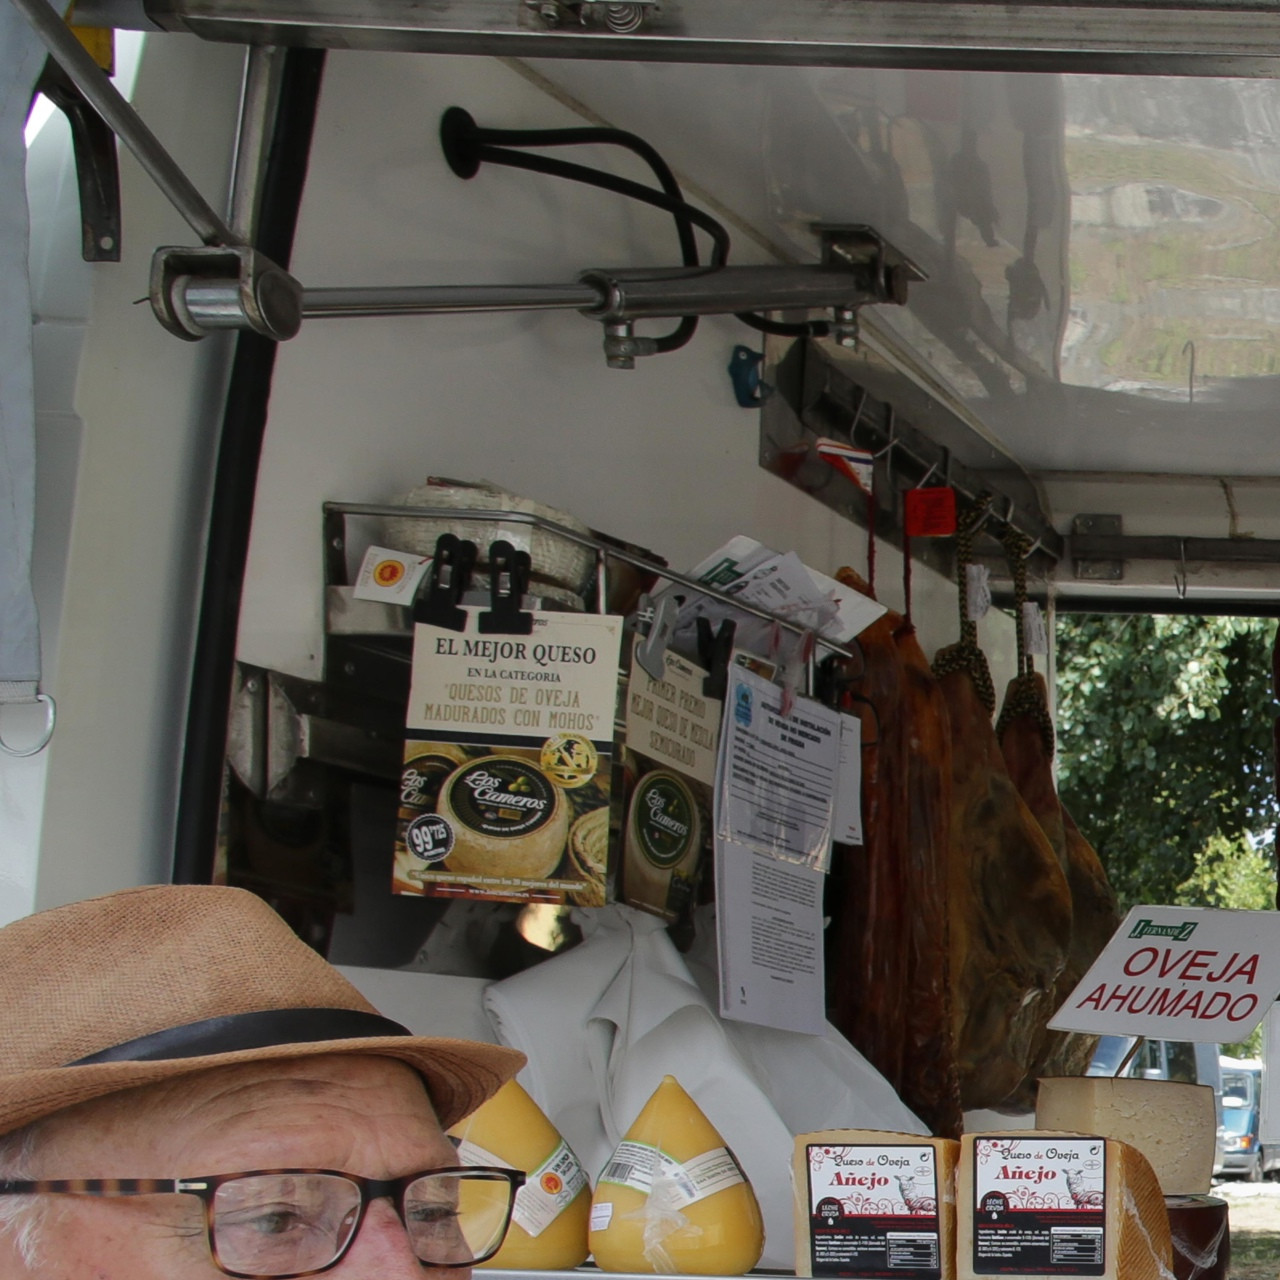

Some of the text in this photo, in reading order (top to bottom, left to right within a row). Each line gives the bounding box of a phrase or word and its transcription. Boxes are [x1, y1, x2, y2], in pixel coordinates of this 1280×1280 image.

[435, 637, 597, 667] EL MEJOR QUESO
[467, 667, 562, 683] EN LA CATEGORIA
[509, 686, 529, 705] DE
[535, 689, 581, 708] OVEJA
[424, 703, 506, 725] MADURADOS
[514, 709, 541, 727] CON
[464, 770, 502, 789] Los
[473, 786, 547, 810] Cameros
[1122, 946, 1261, 985] OVEJA
[1075, 982, 1260, 1023] AHUMADO
[827, 1154, 911, 1169] Queso de Oveja
[1001, 1147, 1080, 1163] Queso de Oveja
[828, 1170, 890, 1191] Añejo
[994, 1164, 1057, 1185] Añejo
